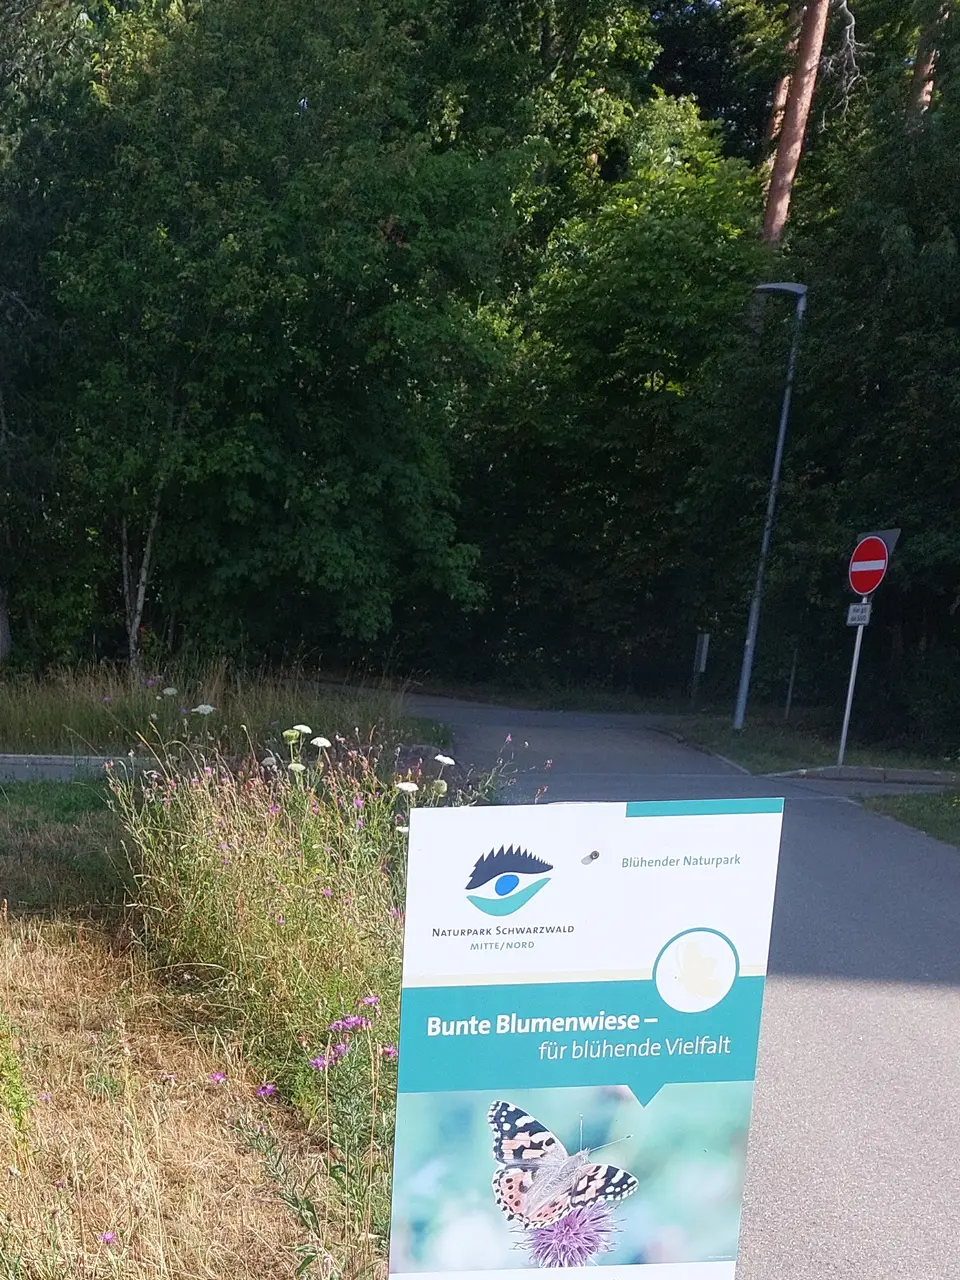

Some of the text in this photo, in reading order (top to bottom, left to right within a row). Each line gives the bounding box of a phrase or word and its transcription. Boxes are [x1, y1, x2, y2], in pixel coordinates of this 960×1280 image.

[622, 854, 741, 869] Blühender Naturpark
[470, 940, 535, 951] MITTE/NORD
[427, 1016, 491, 1036] Bunte
[496, 1011, 640, 1034] Blumenwiese
[538, 1035, 731, 1061] für blühende Vielfalt
